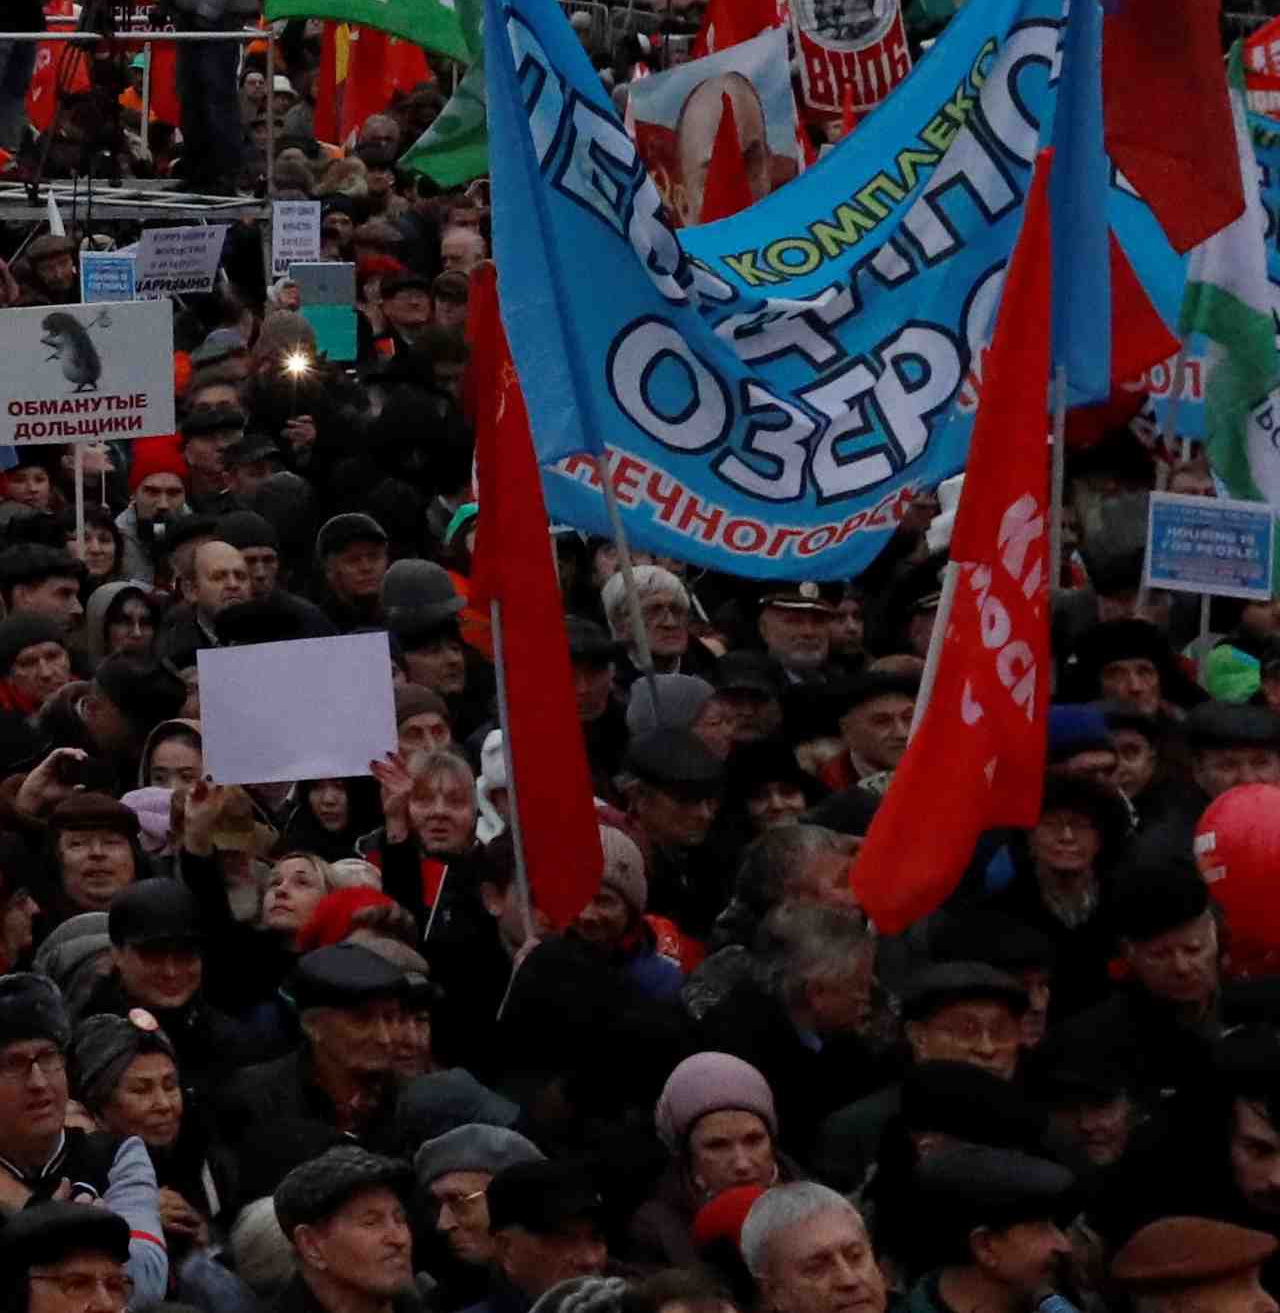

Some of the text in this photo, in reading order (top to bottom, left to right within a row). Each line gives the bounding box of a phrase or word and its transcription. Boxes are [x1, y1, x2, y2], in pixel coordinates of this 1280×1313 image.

[724, 37, 998, 287] КОМПЛЕКС
[8, 393, 148, 417] ОБМАНУТЫЕ
[14, 415, 143, 440] ДОЛЬЩИКИ
